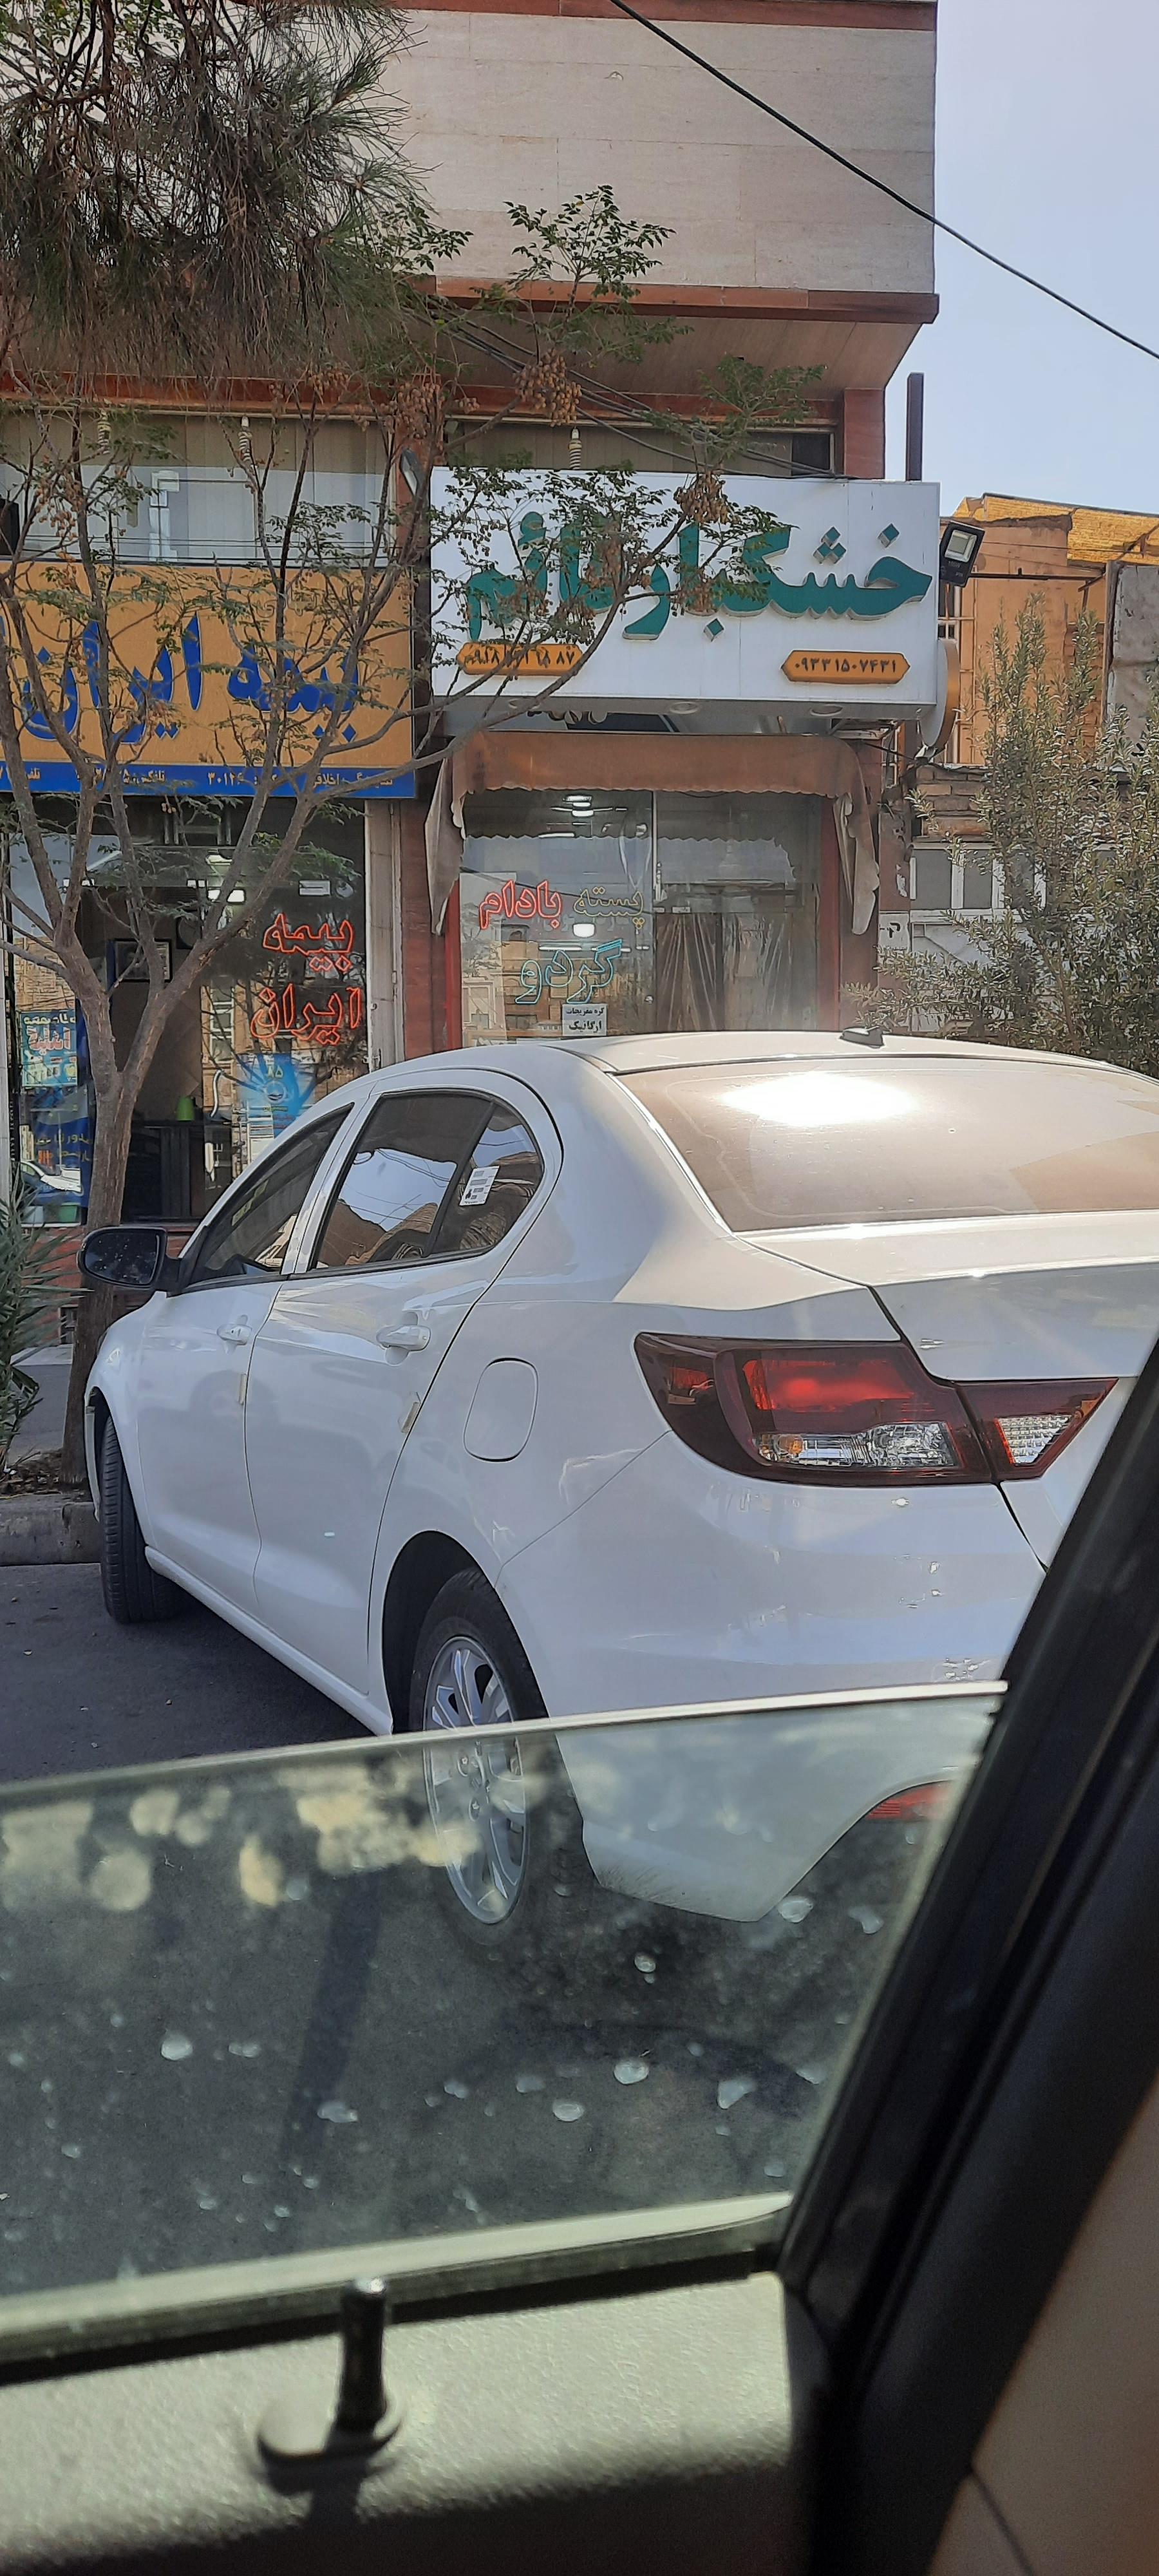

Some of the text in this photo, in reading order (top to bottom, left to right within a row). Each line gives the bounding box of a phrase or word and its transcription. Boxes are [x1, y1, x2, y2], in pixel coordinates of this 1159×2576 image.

[621, 519, 933, 643] خشکبار
[22, 611, 360, 744] بیمه ایران
[479, 880, 645, 930] پسته بادام
[263, 913, 354, 972] بیمه
[515, 939, 623, 1004] گردو
[250, 983, 361, 1046] ایران
[569, 1021, 602, 1033] ارگانیک
